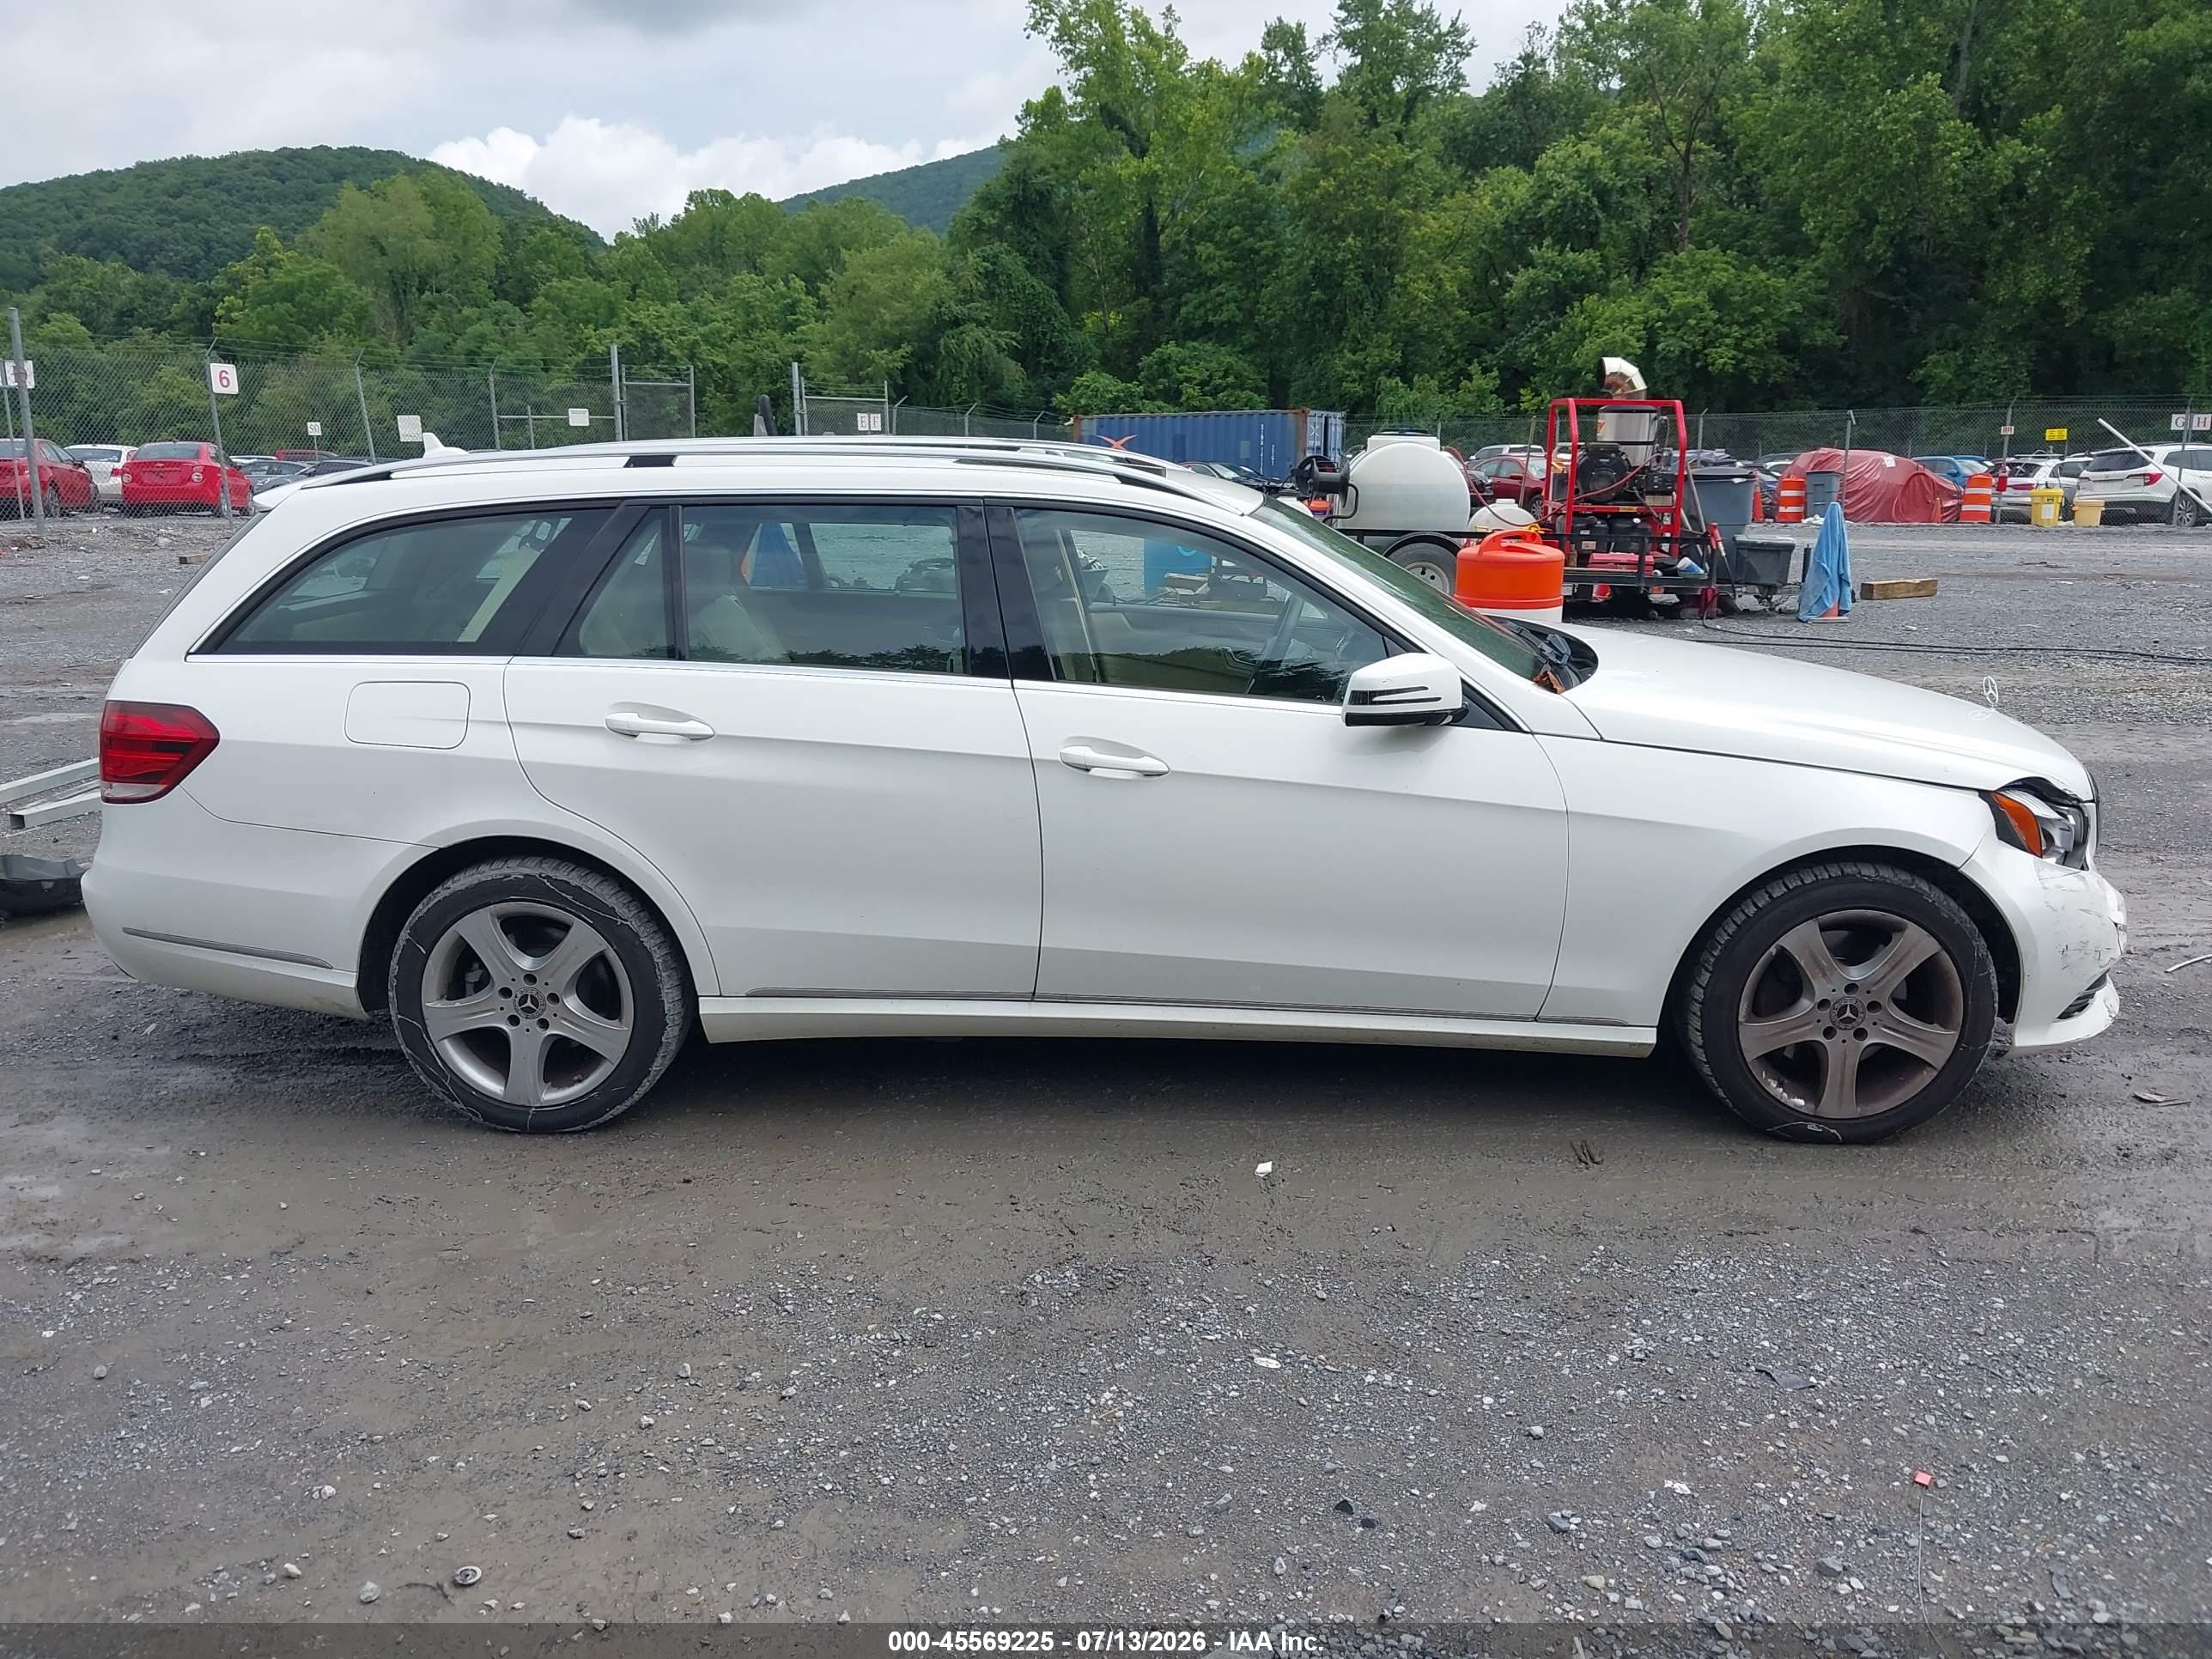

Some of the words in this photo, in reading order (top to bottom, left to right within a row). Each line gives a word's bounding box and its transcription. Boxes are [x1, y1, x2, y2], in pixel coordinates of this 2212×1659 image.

[219, 370, 231, 388] 6
[860, 416, 867, 428] E
[872, 416, 879, 428] F
[2175, 416, 2185, 428] G
[2197, 416, 2208, 428] H
